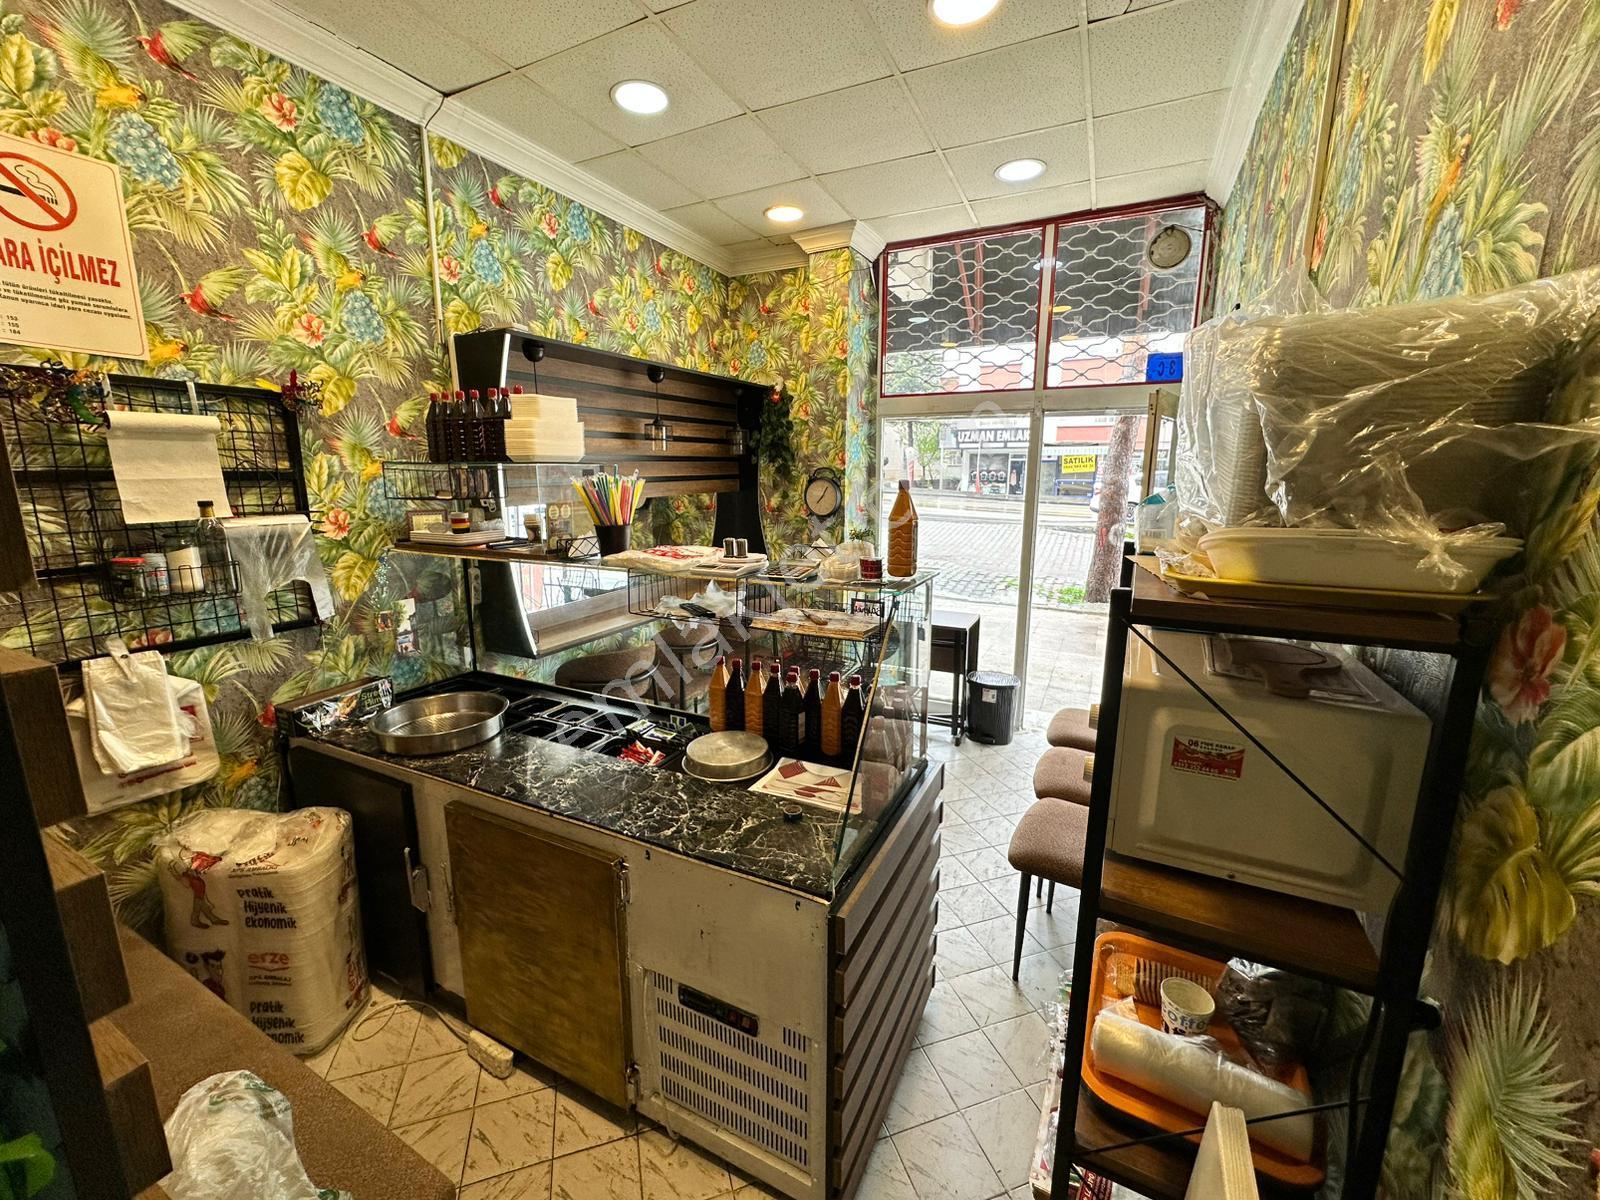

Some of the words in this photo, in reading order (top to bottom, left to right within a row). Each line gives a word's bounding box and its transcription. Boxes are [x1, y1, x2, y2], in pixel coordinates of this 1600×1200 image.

[37, 238, 121, 287] İÇİLMEZ
[957, 430, 995, 443] UZMAN
[996, 430, 1031, 442] EMLAK
[1063, 456, 1094, 465] SATILIK
[244, 900, 287, 916] Hijyenik
[245, 915, 297, 929] ekonomik
[248, 952, 290, 965] erze
